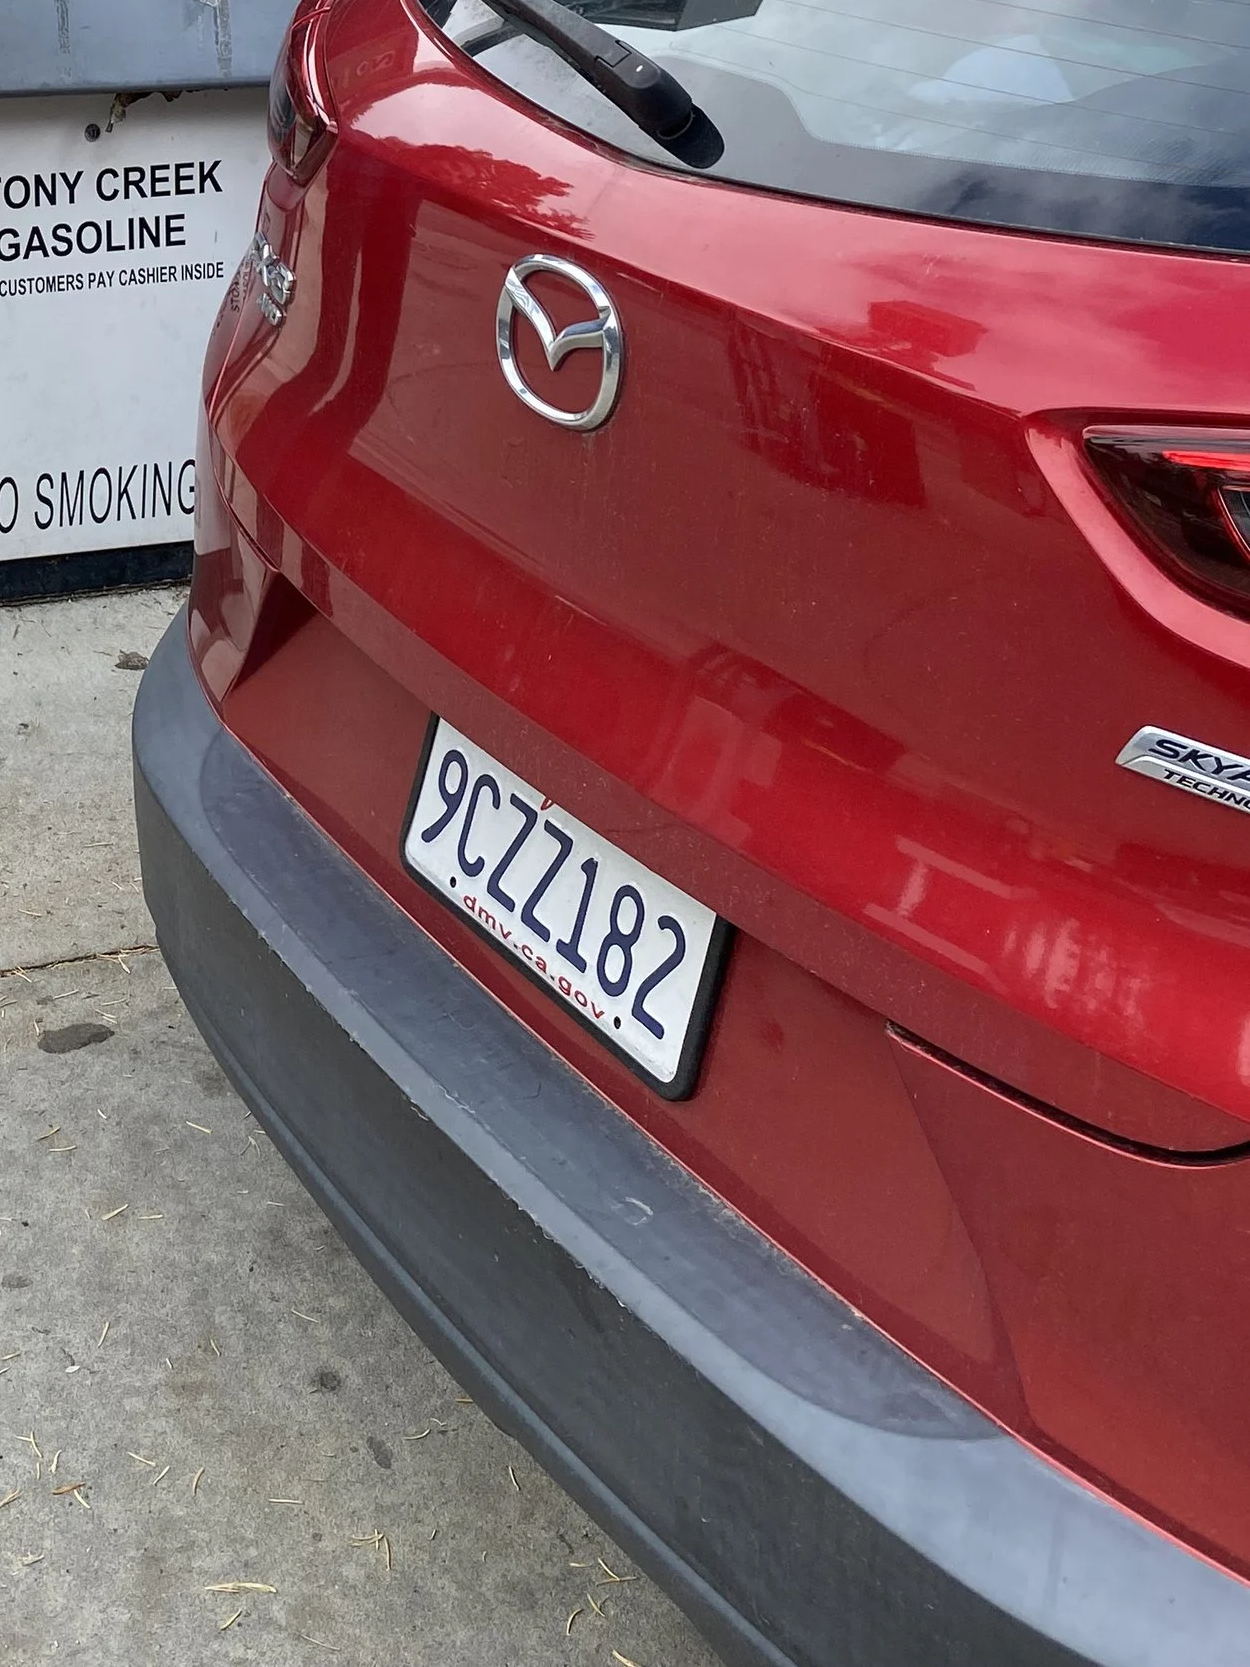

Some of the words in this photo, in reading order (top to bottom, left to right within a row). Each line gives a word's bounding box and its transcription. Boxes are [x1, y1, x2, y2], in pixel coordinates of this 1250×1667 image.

[96, 160, 223, 201] CREEK
[88, 271, 115, 289] PAY
[119, 266, 178, 286] CASHIER
[181, 262, 224, 280] INSIDE
[34, 459, 196, 530] SMOKING
[421, 749, 686, 1040] 9CZZ182
[463, 892, 605, 1020] dmv.ca.gov
